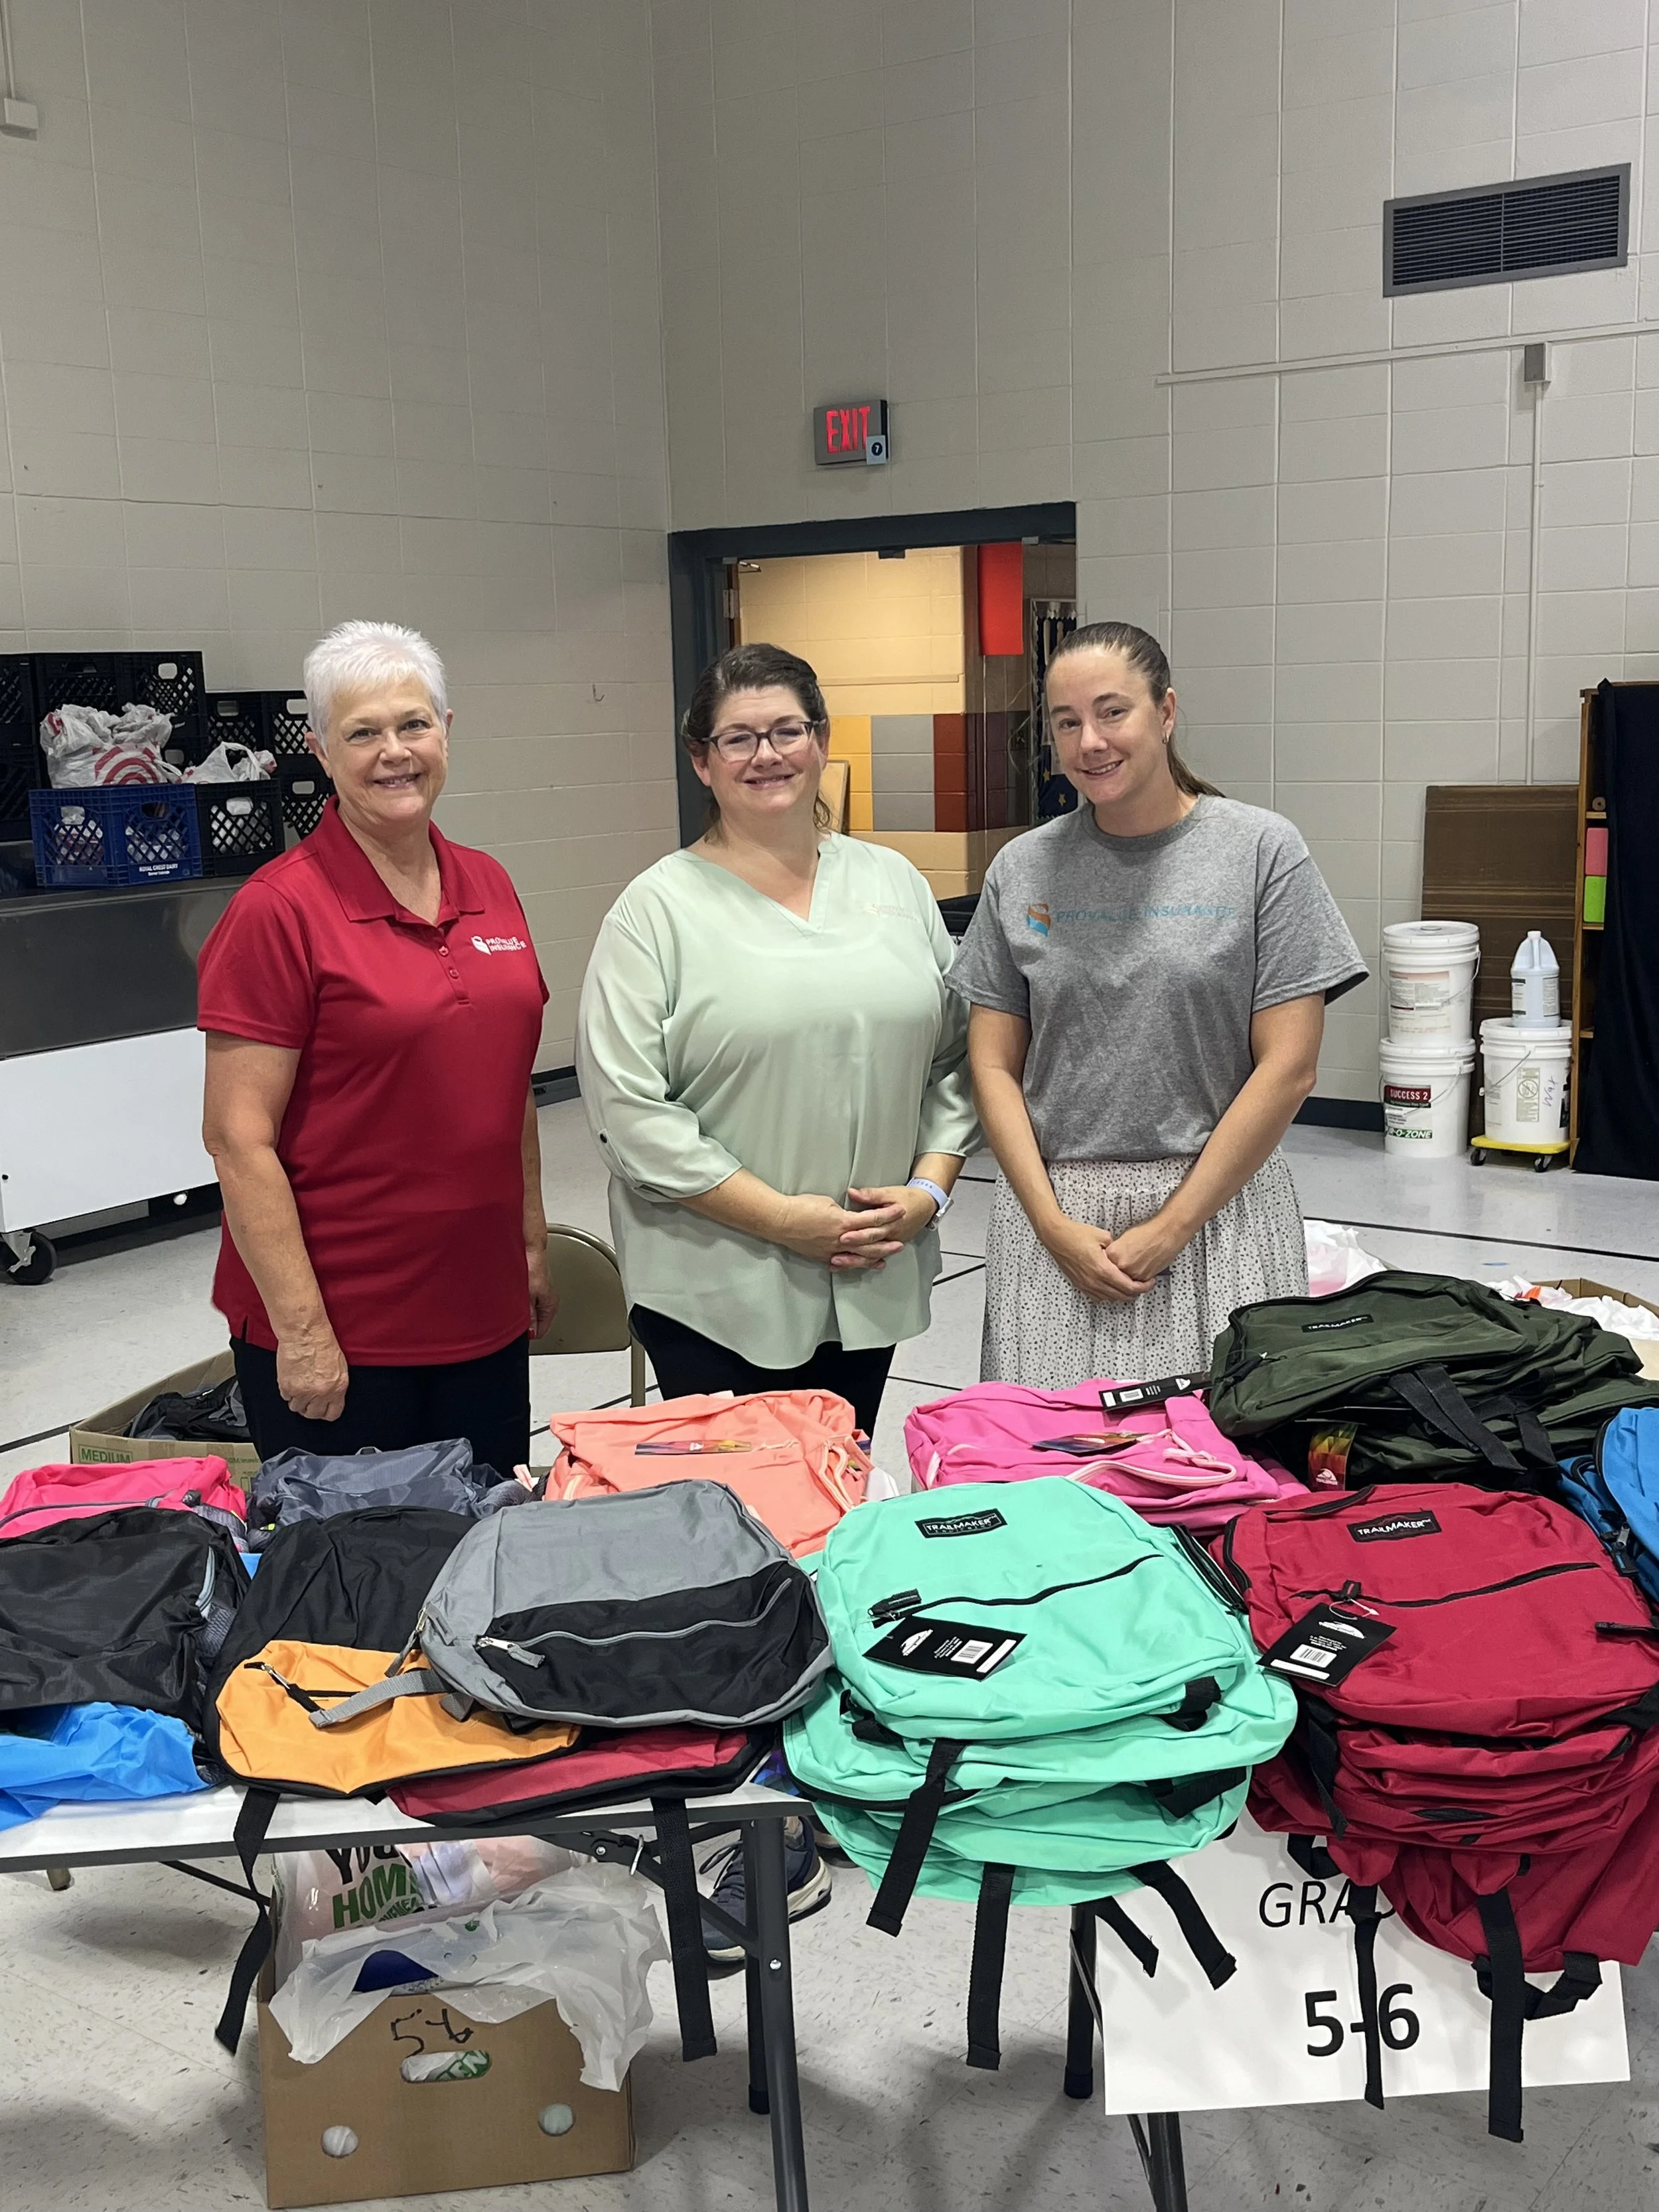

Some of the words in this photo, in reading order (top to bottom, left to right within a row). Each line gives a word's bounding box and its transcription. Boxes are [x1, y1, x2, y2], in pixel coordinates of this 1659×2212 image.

[826, 406, 871, 454] EXIT
[874, 445, 880, 453] 7
[1390, 1089, 1420, 1100] SUCCESS
[1423, 1092, 1428, 1100] 2
[81, 1448, 130, 1463] MEDIUM
[1260, 1878, 1396, 1927] GRA
[1305, 1983, 1419, 2057] 5-6
